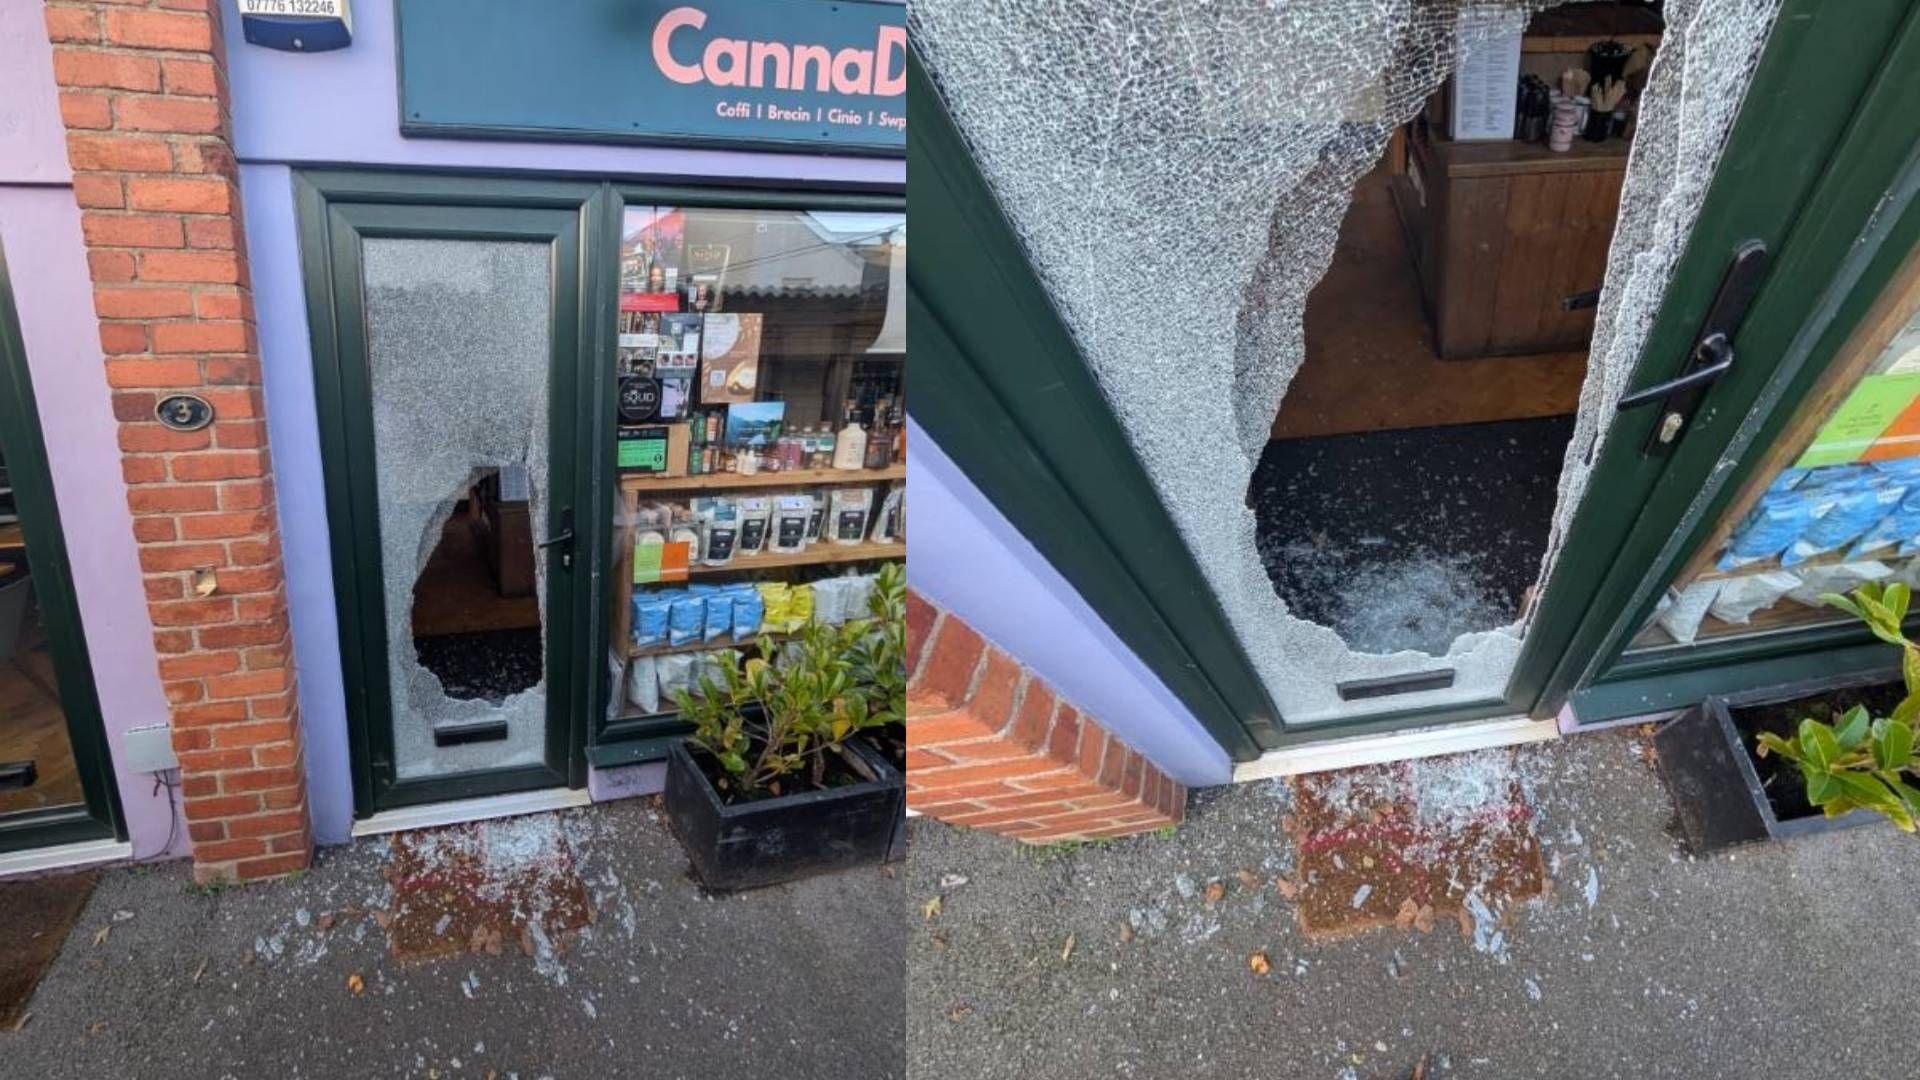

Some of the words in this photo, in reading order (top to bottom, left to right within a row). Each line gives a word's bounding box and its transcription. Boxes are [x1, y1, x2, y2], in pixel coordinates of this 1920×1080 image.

[290, 0, 335, 13] 132246
[652, 7, 906, 96] CannaD
[716, 102, 750, 118] Coffi
[768, 104, 811, 122] Brecin
[827, 109, 863, 126] Cinio
[175, 402, 192, 423] 3
